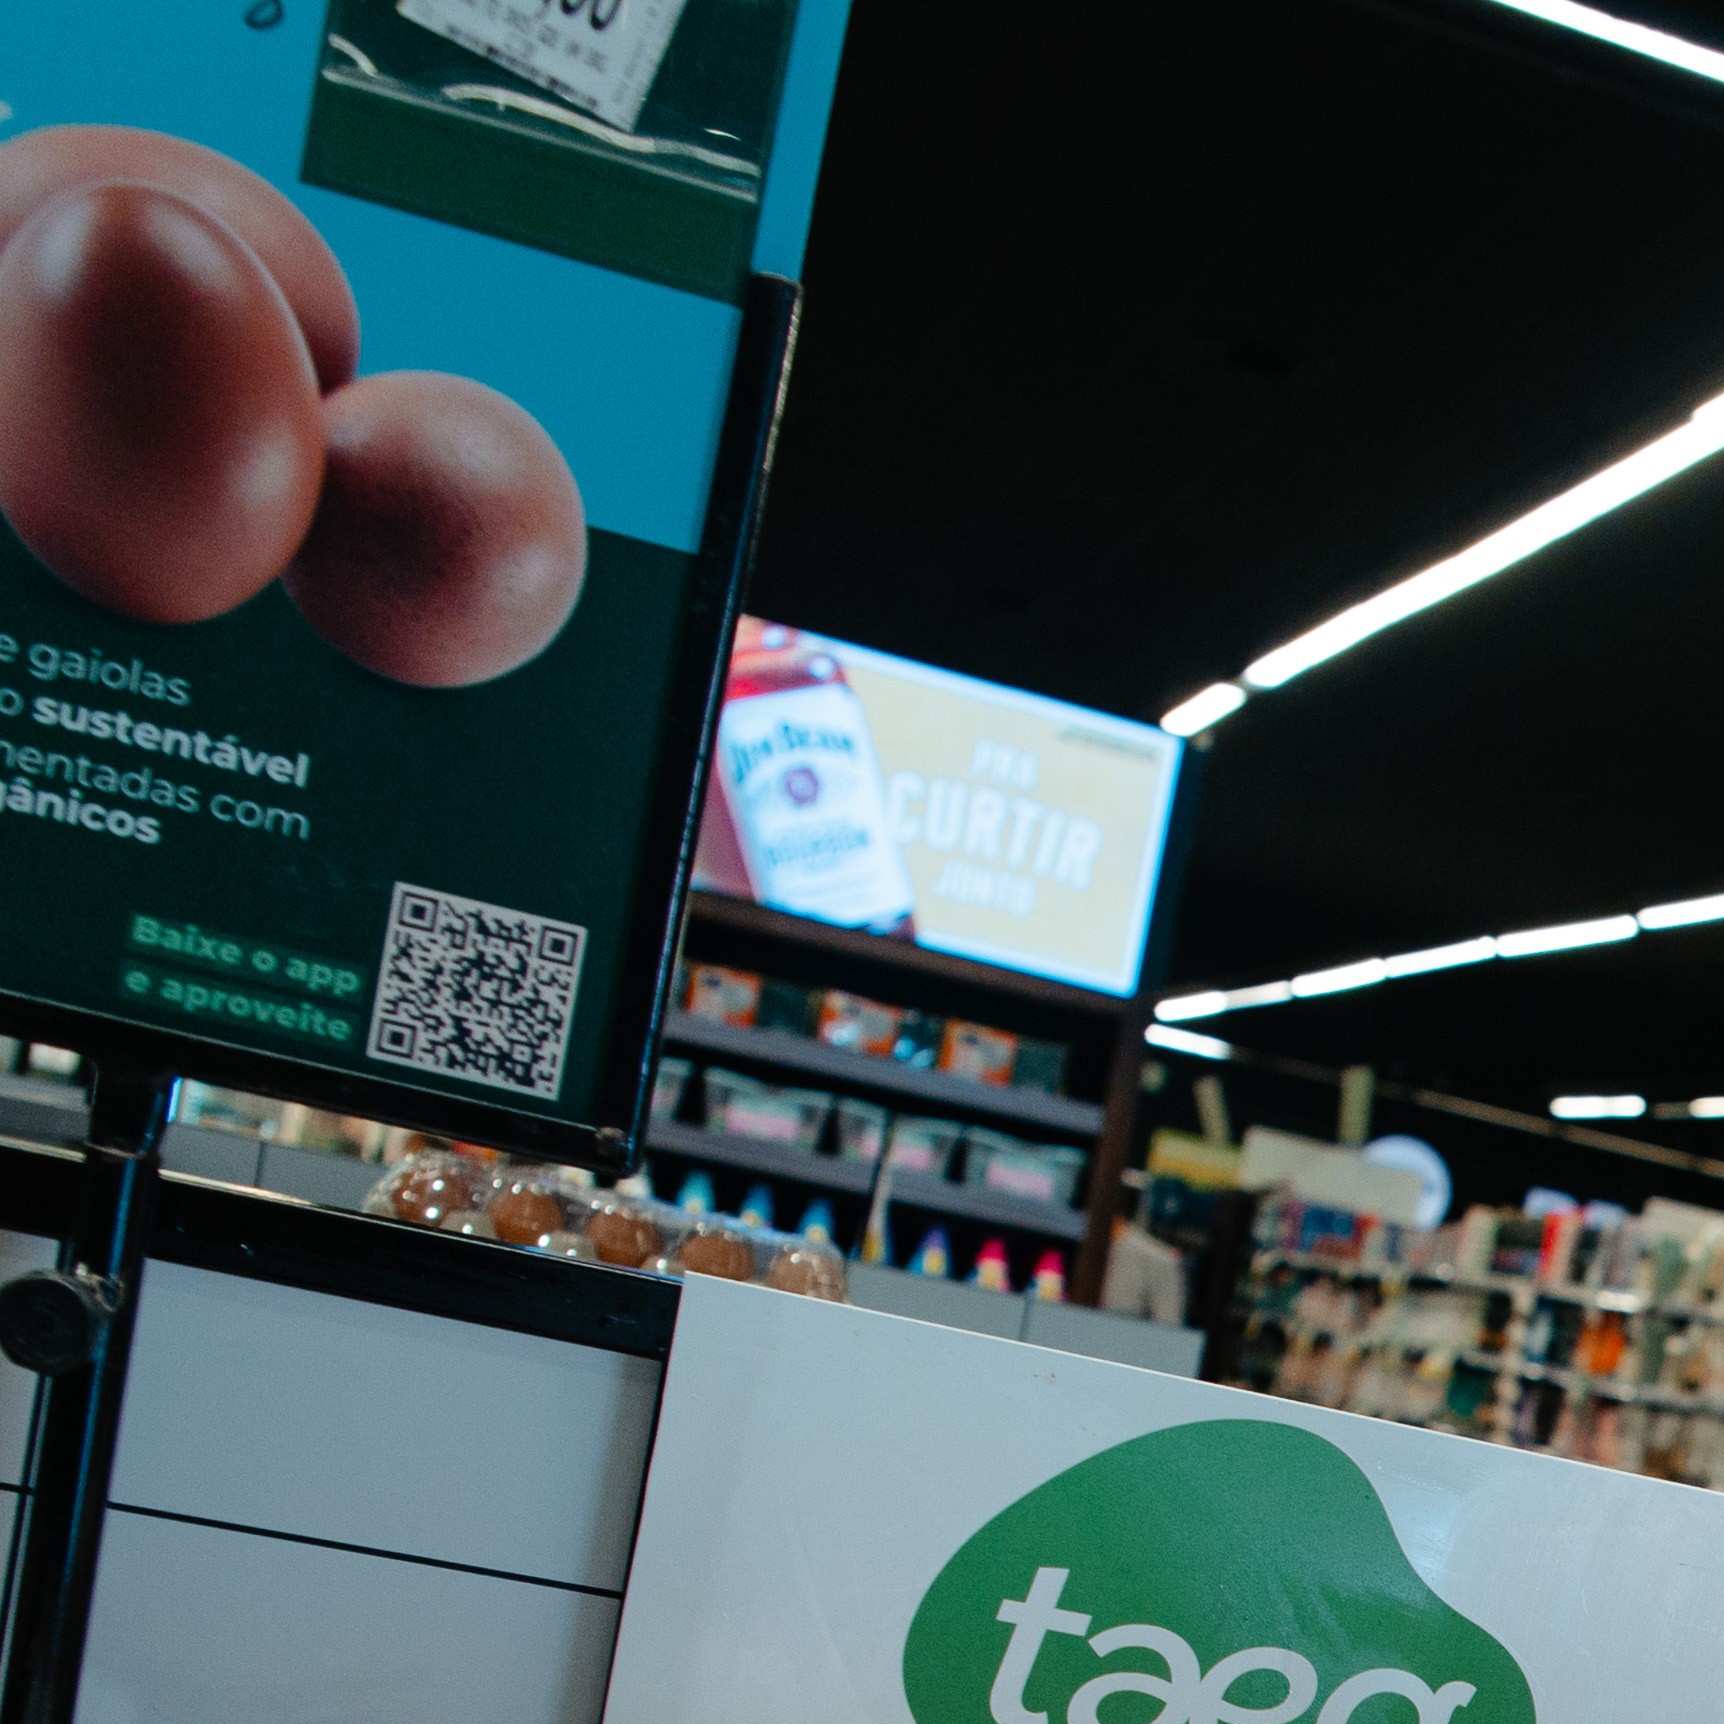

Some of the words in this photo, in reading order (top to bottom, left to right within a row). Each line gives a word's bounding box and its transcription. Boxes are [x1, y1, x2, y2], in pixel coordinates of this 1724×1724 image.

[27, 643, 191, 707] gaiolas
[32, 697, 311, 789] sustentável
[0, 776, 161, 844] ânicos
[210, 793, 310, 841] com
[888, 770, 1102, 893] CURTIR
[131, 914, 241, 966] Baixe
[251, 945, 279, 973] o
[286, 958, 361, 998] app
[125, 968, 150, 994] e
[160, 975, 352, 1041] aproveite
